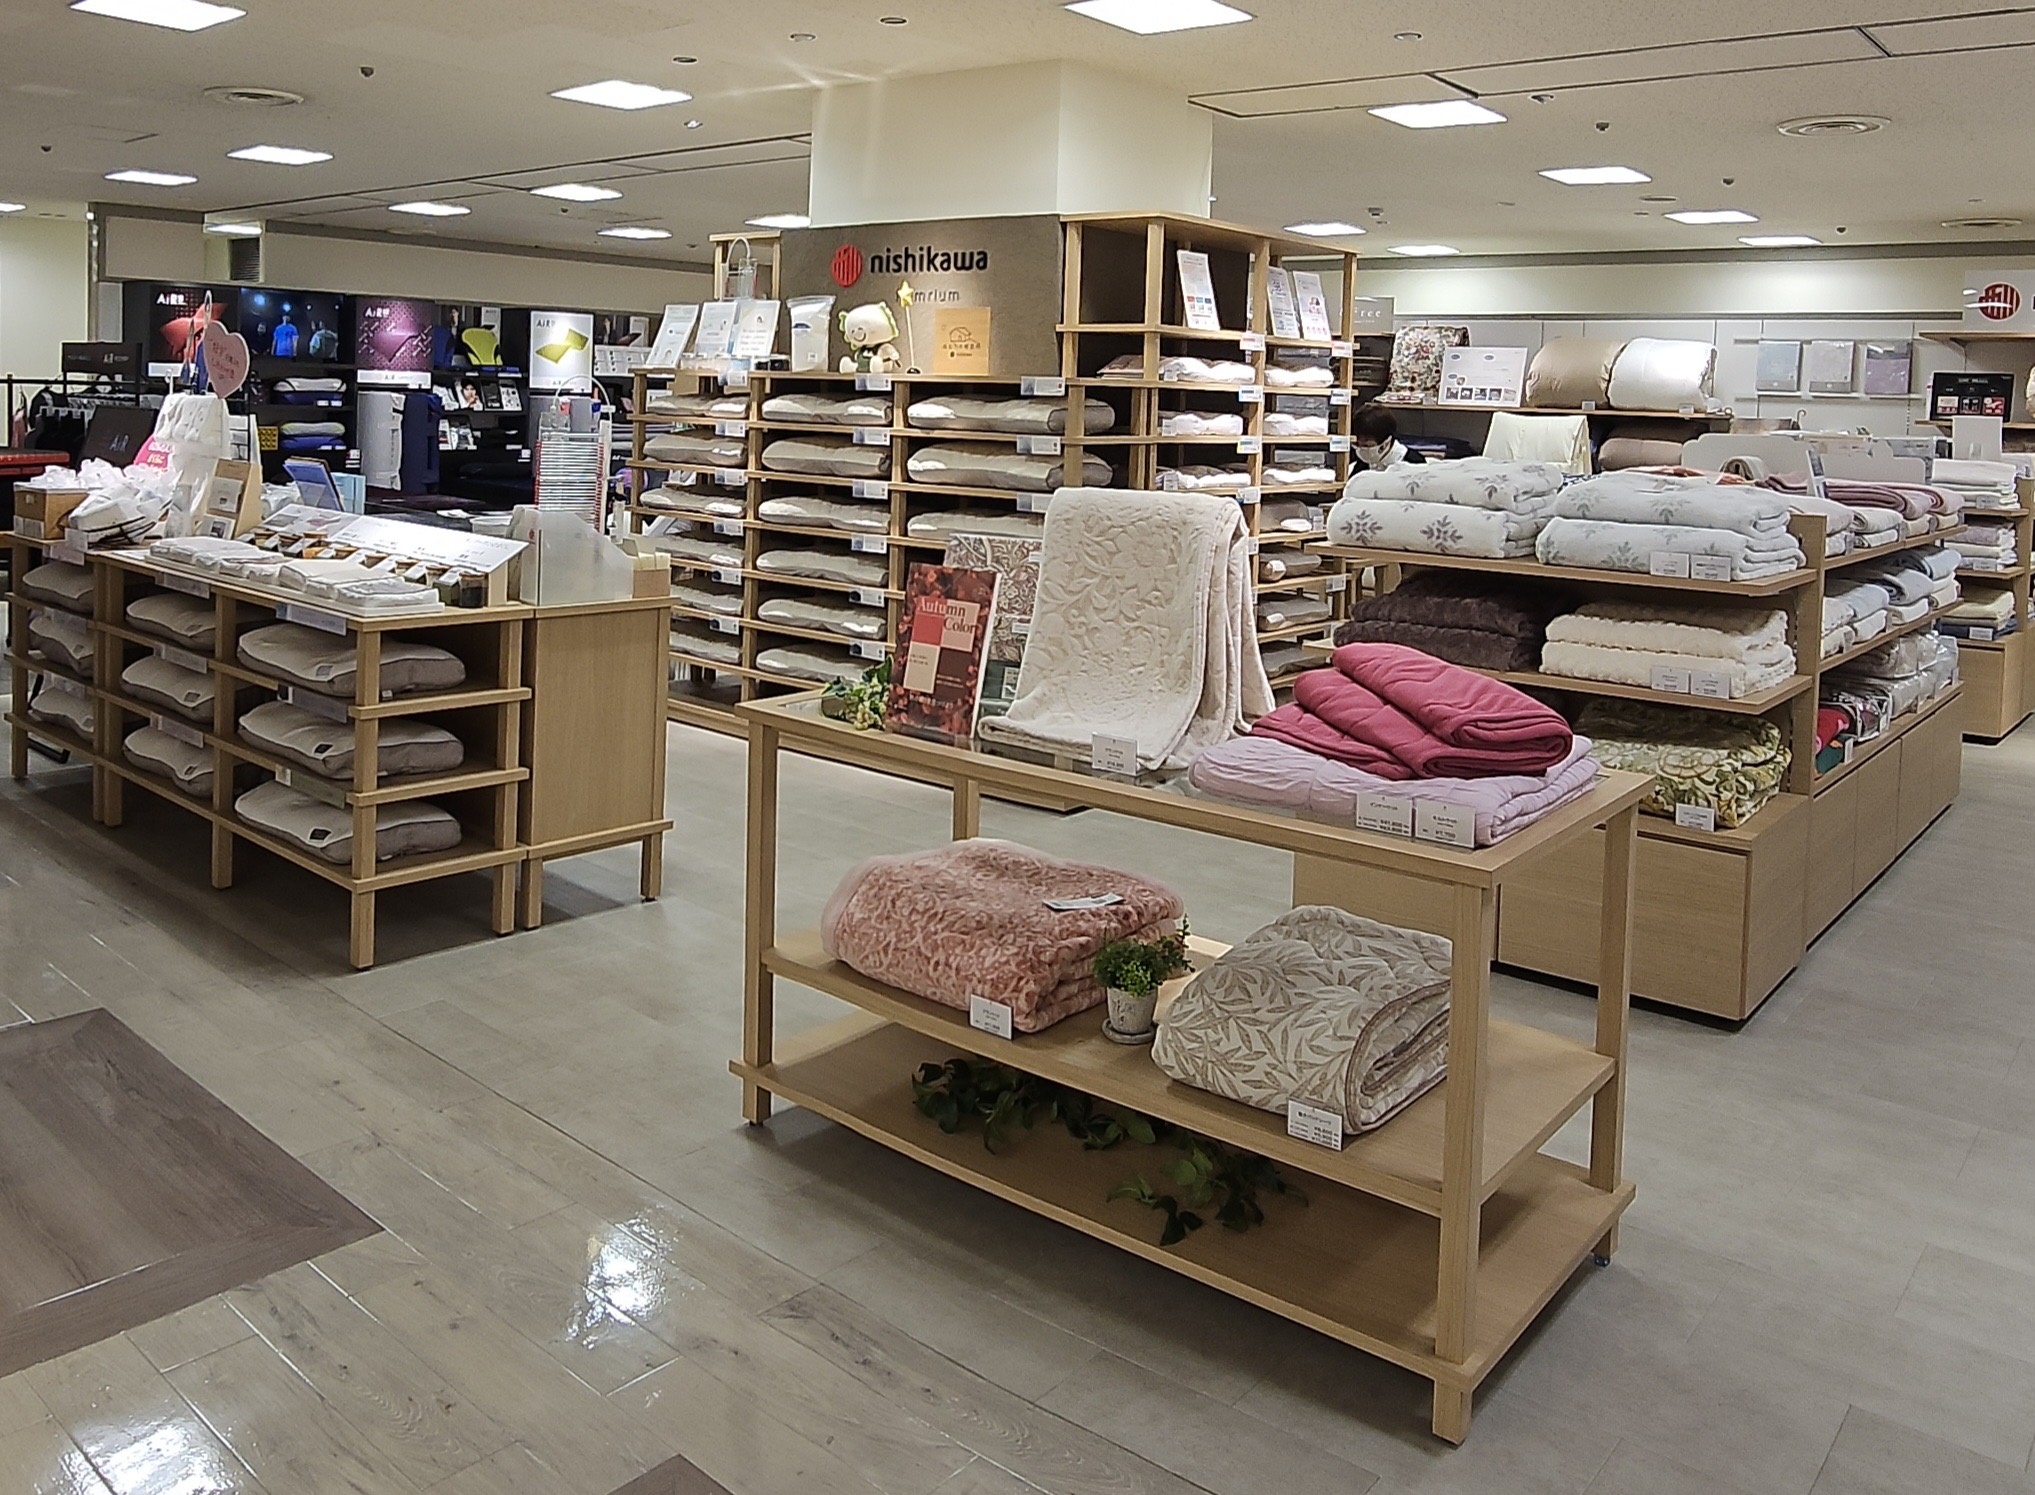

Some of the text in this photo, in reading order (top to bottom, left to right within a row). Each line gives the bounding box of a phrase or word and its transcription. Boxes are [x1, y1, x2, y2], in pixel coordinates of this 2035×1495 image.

[870, 246, 989, 273] nishikawa
[917, 598, 966, 617] Autumn
[943, 616, 978, 635] Color
